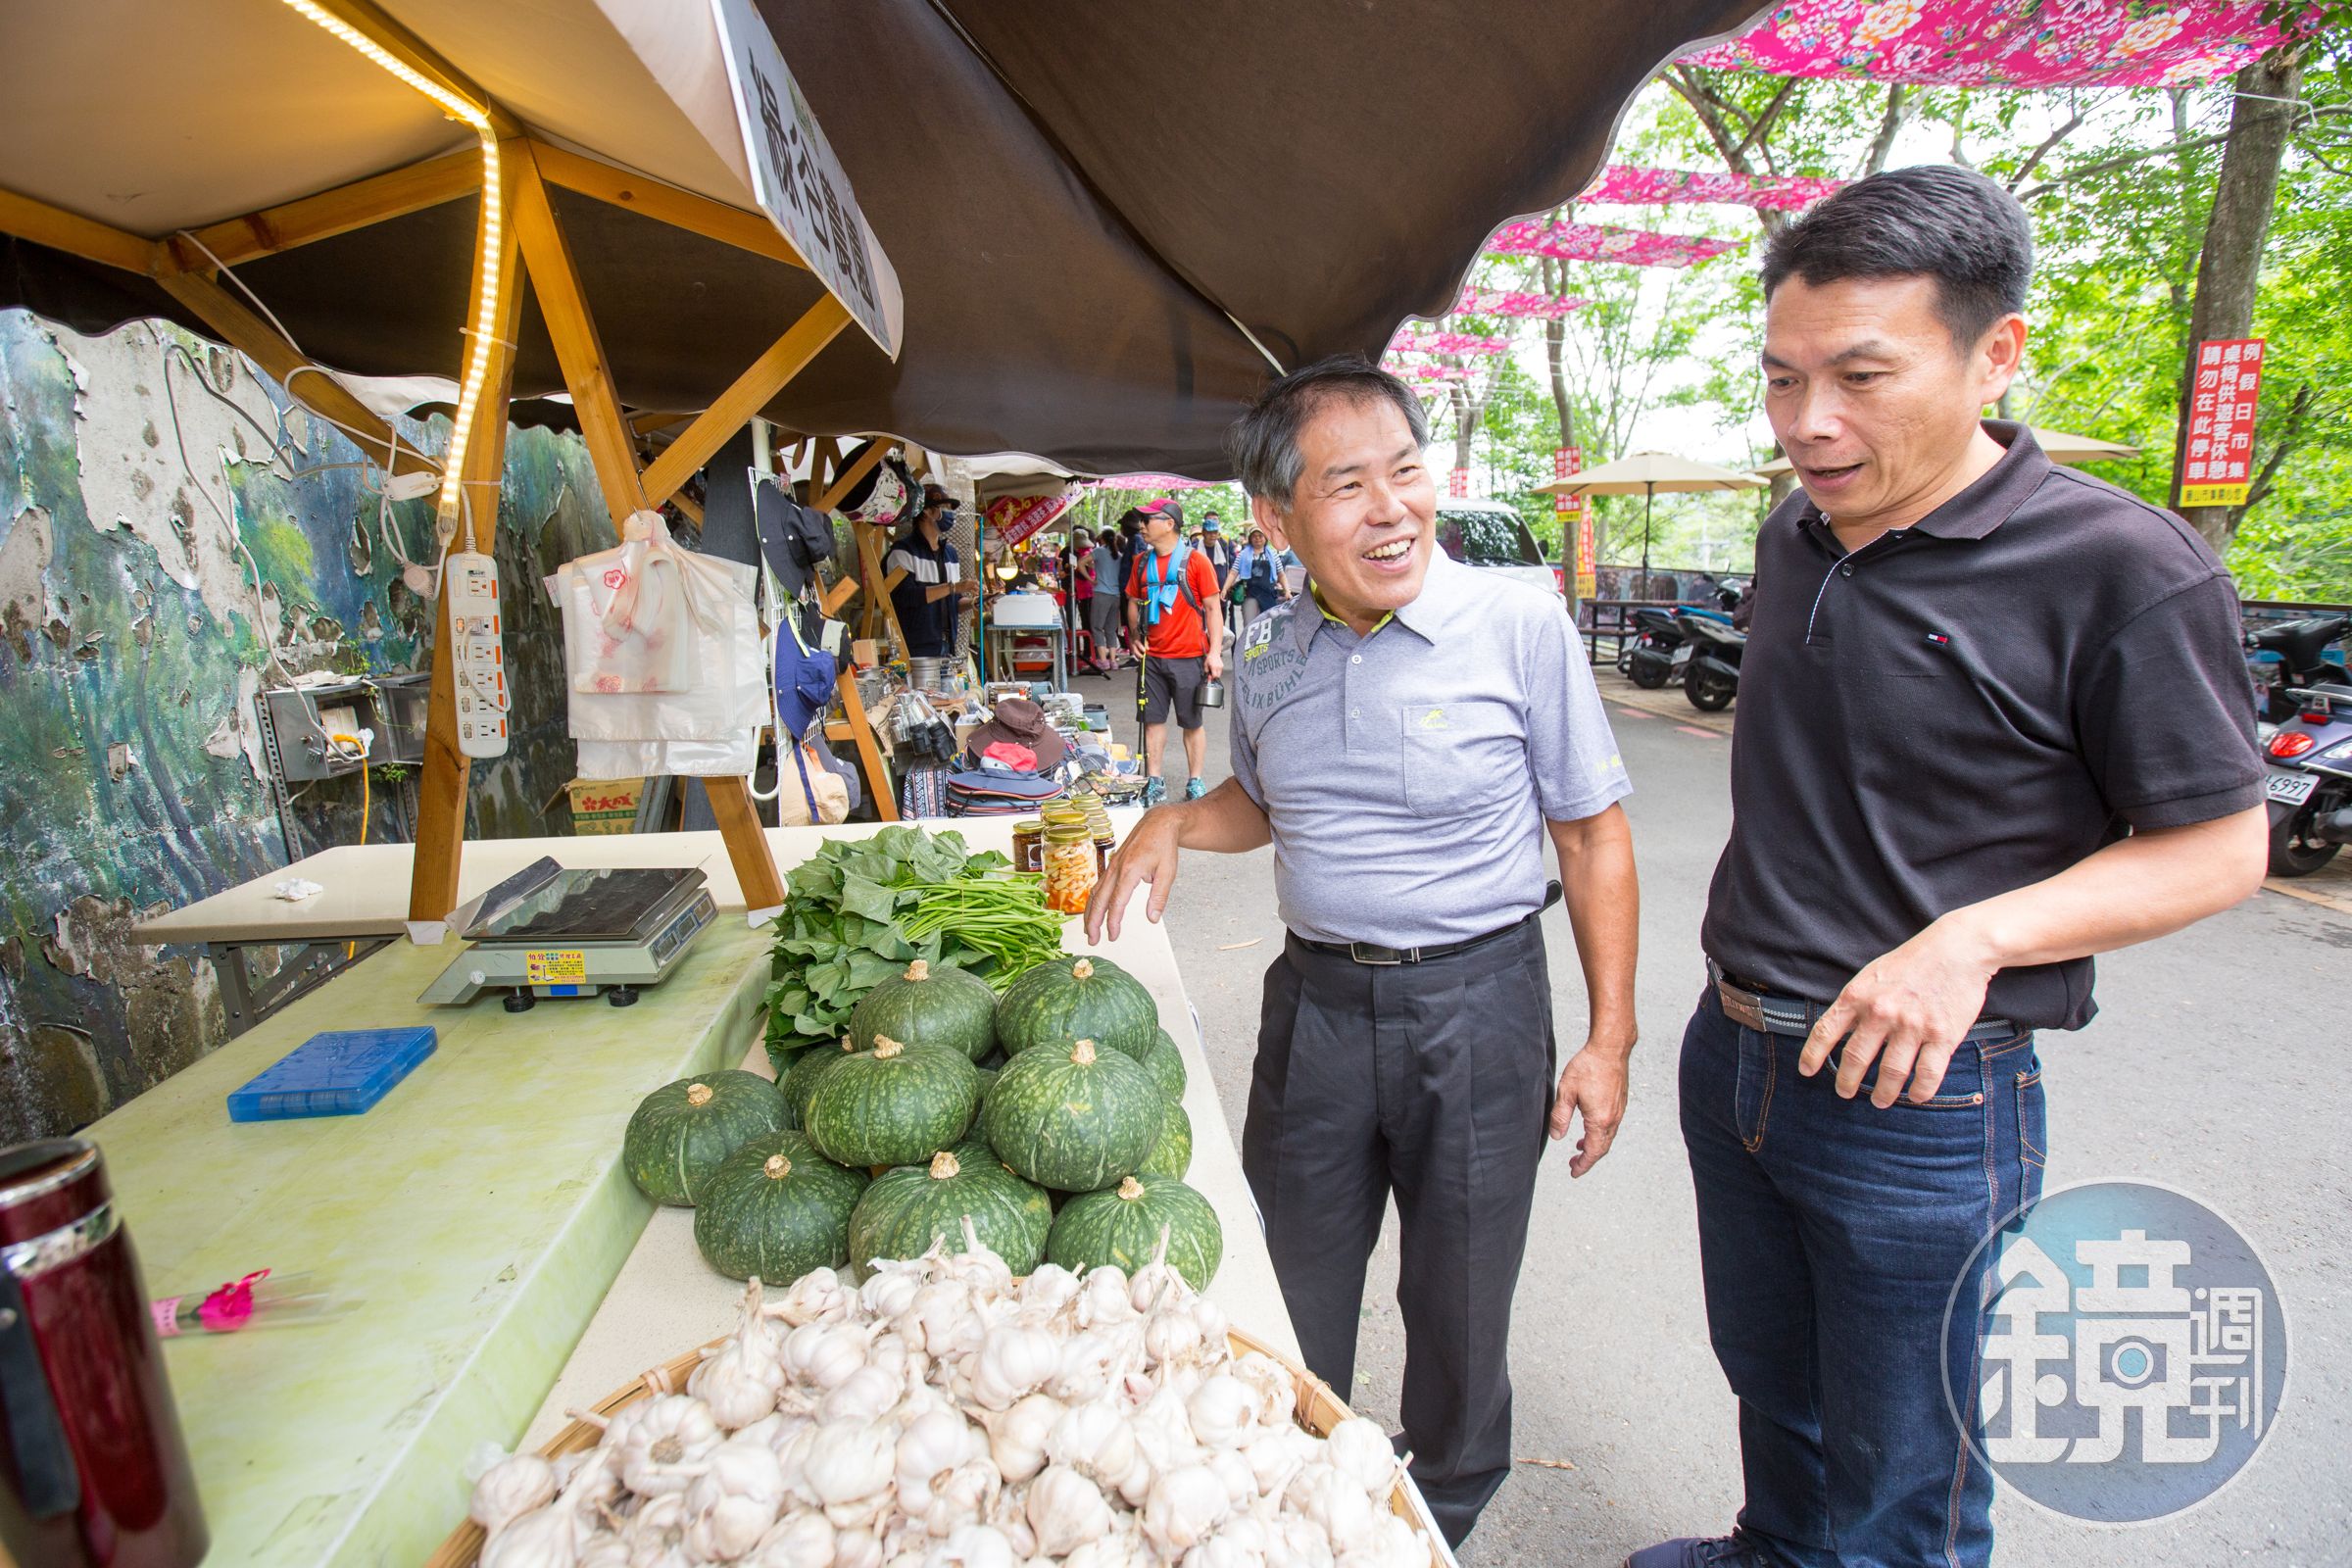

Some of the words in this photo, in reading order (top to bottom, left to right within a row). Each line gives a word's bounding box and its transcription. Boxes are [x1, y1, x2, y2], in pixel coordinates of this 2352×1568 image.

[2187, 346, 2223, 480] 請勿在此停車
[2207, 345, 2242, 479] 桌椅供遊客休憩
[2227, 343, 2262, 478] 例假日市集
[1244, 618, 1272, 650] FB
[1244, 644, 1269, 662] SPORTS
[1256, 649, 1296, 676] SPORTS
